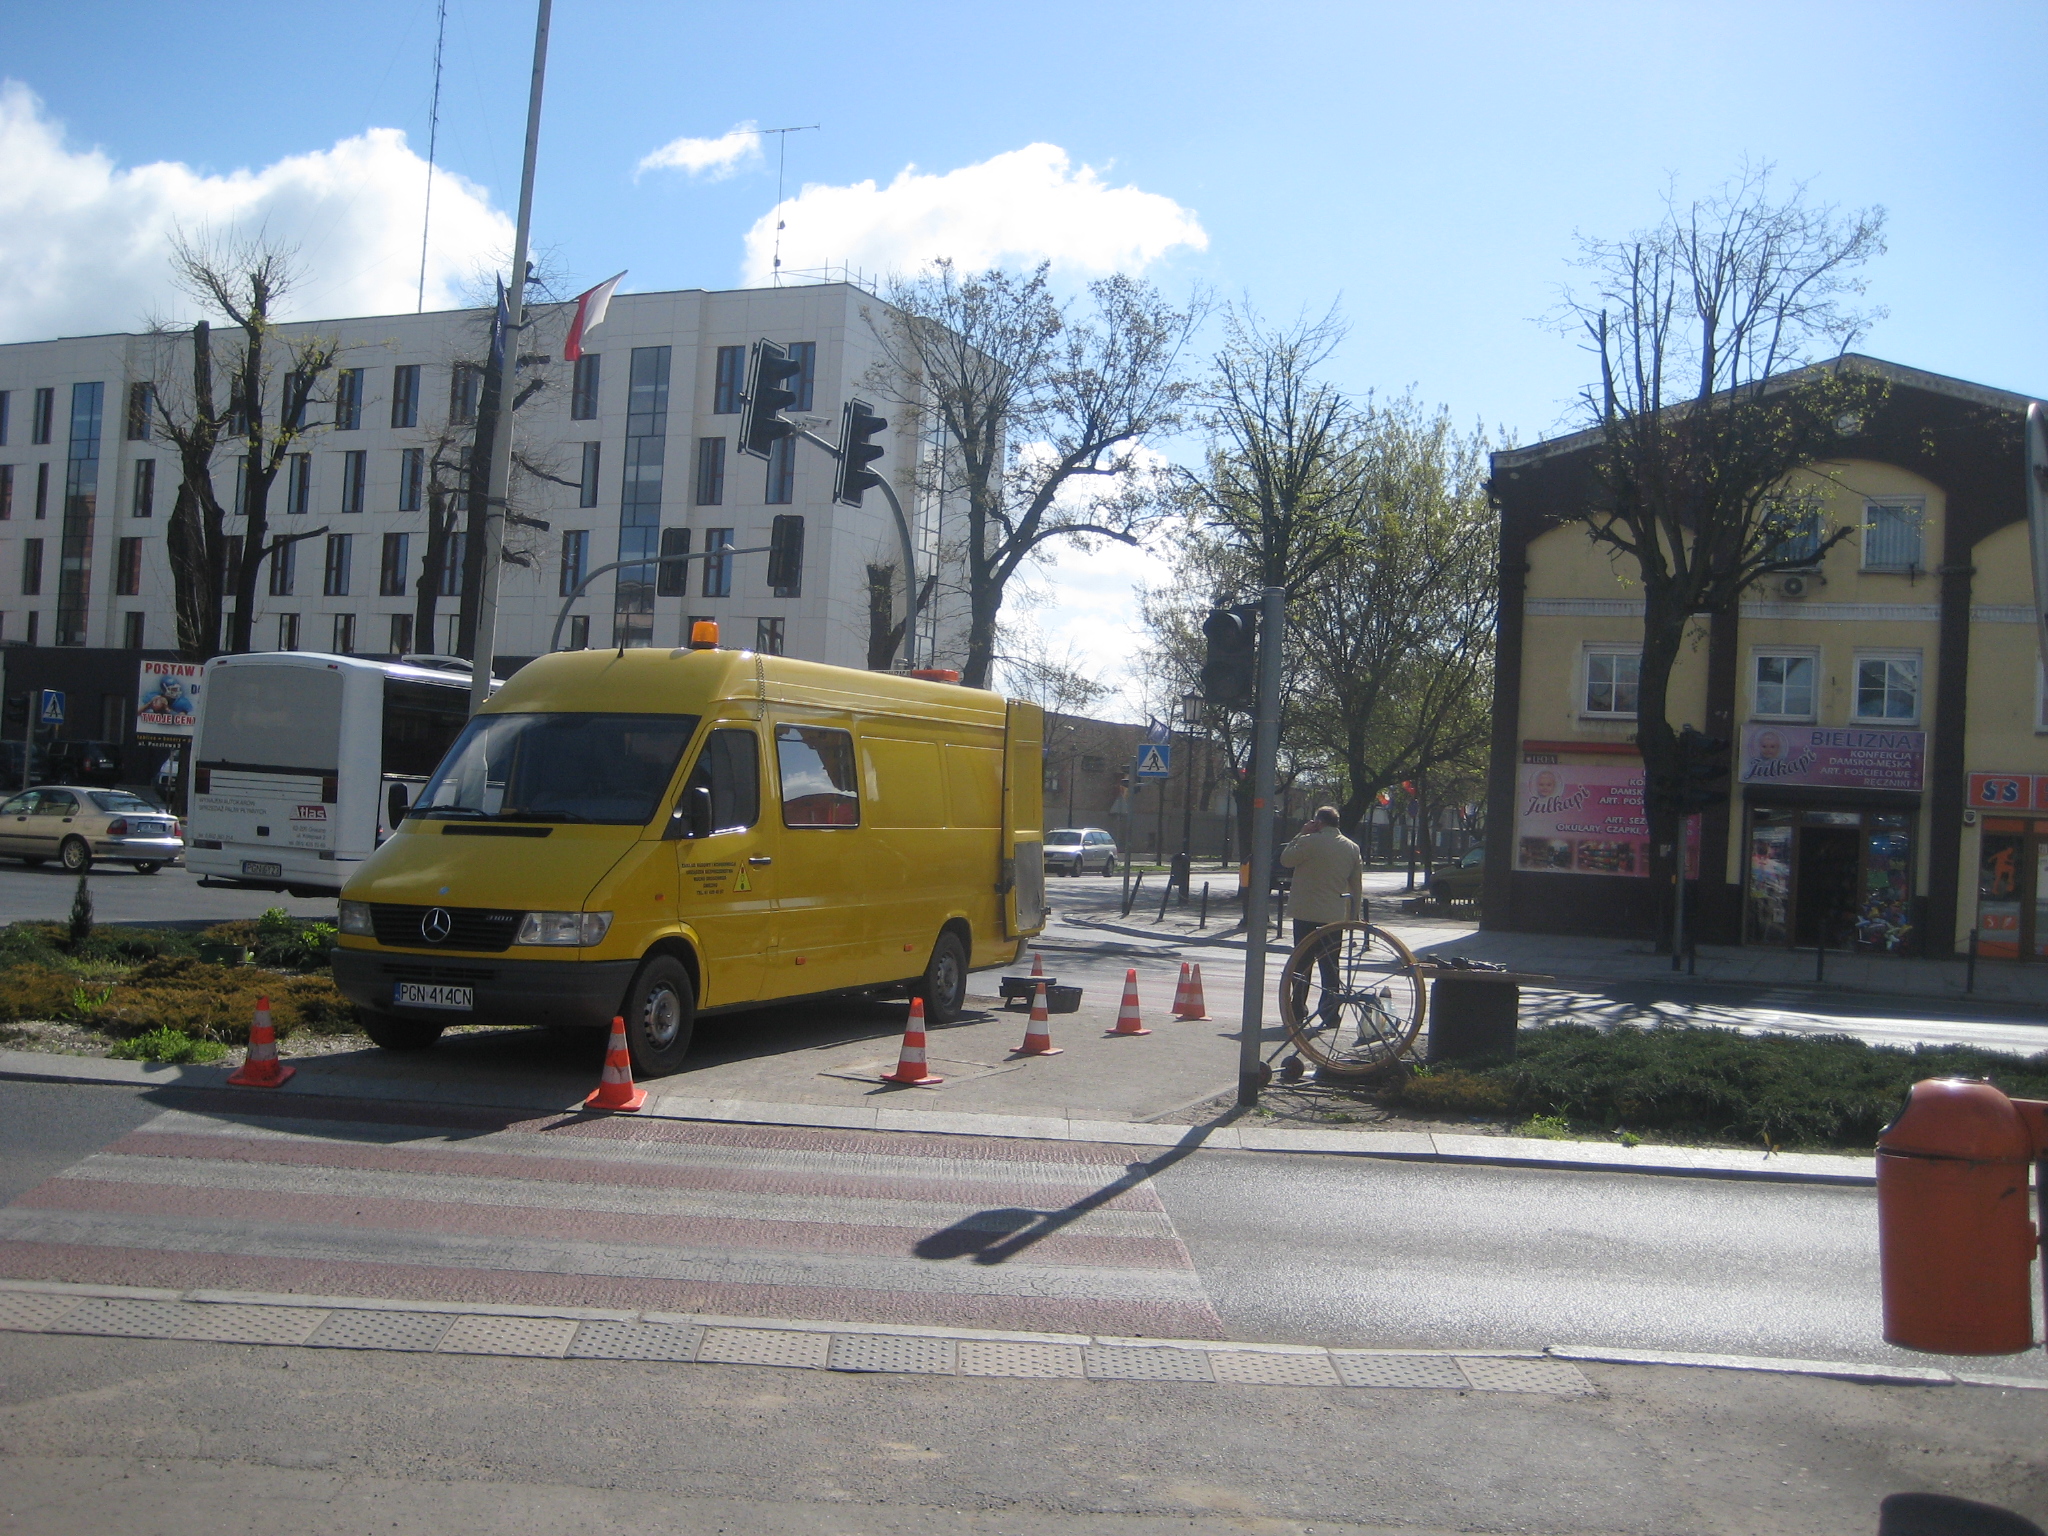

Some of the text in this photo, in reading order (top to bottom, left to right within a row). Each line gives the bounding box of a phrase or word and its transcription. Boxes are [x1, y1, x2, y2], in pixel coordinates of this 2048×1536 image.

[145, 662, 195, 677] POSTAW
[141, 713, 172, 724] TWOJE
[1811, 731, 1912, 750] BIELIZNA
[1850, 750, 1912, 760] KONFEKCJA
[1744, 745, 1817, 780] Julkapi
[1829, 757, 1912, 769] DAMSKO-MĘSKA
[1819, 766, 1910, 778] ART. POŚCIELOWE
[1863, 777, 1910, 788] RĘCZNIKI
[1981, 778, 2019, 803] STS
[1524, 785, 1591, 816] Julkapi
[1599, 797, 1620, 805] ART.
[290, 806, 326, 819] Atlas
[1605, 816, 1626, 825] ART.
[401, 984, 472, 1006] PGN 414CN
